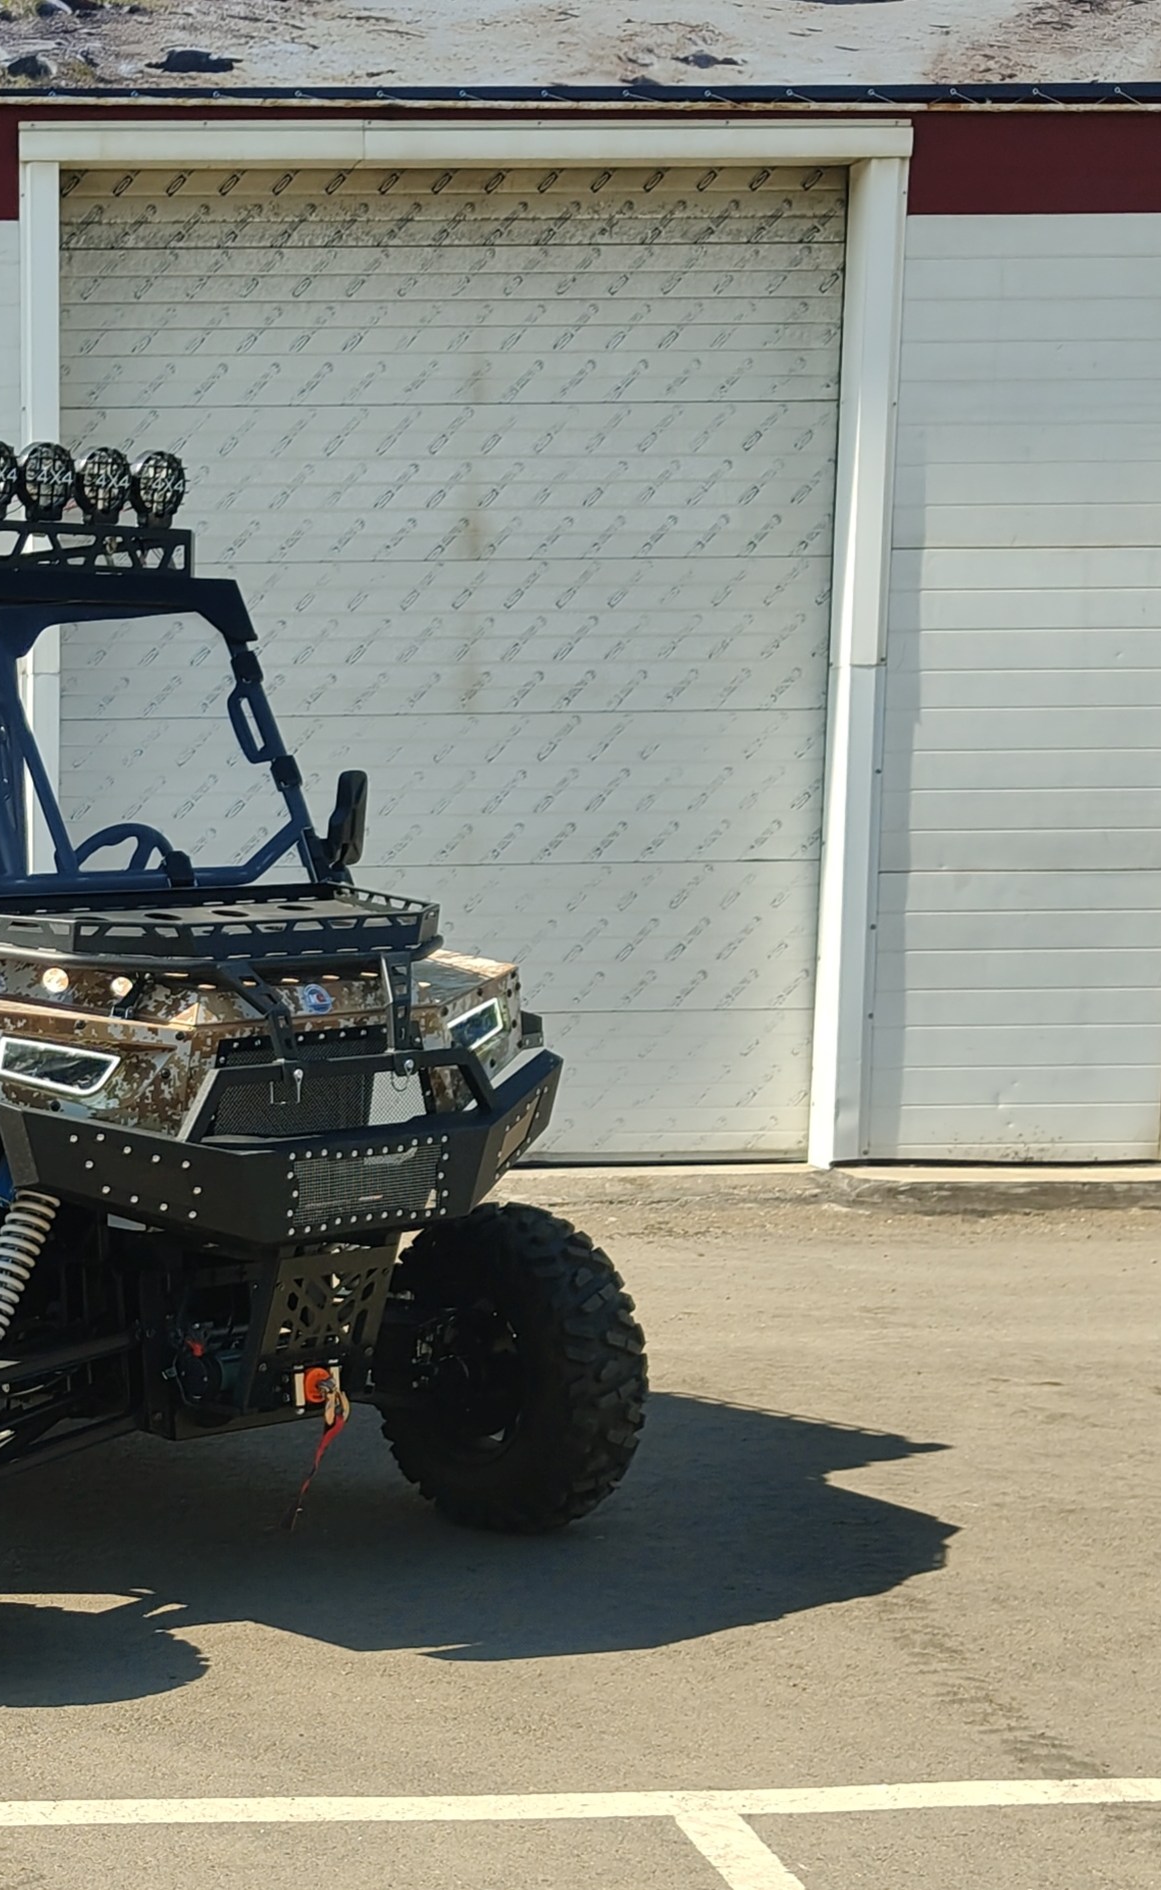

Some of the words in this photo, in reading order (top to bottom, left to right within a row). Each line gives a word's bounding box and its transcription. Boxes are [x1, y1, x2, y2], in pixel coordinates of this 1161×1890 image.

[37, 467, 74, 486] 4X4
[95, 471, 131, 490] 4X4
[151, 475, 185, 493] 4X4
